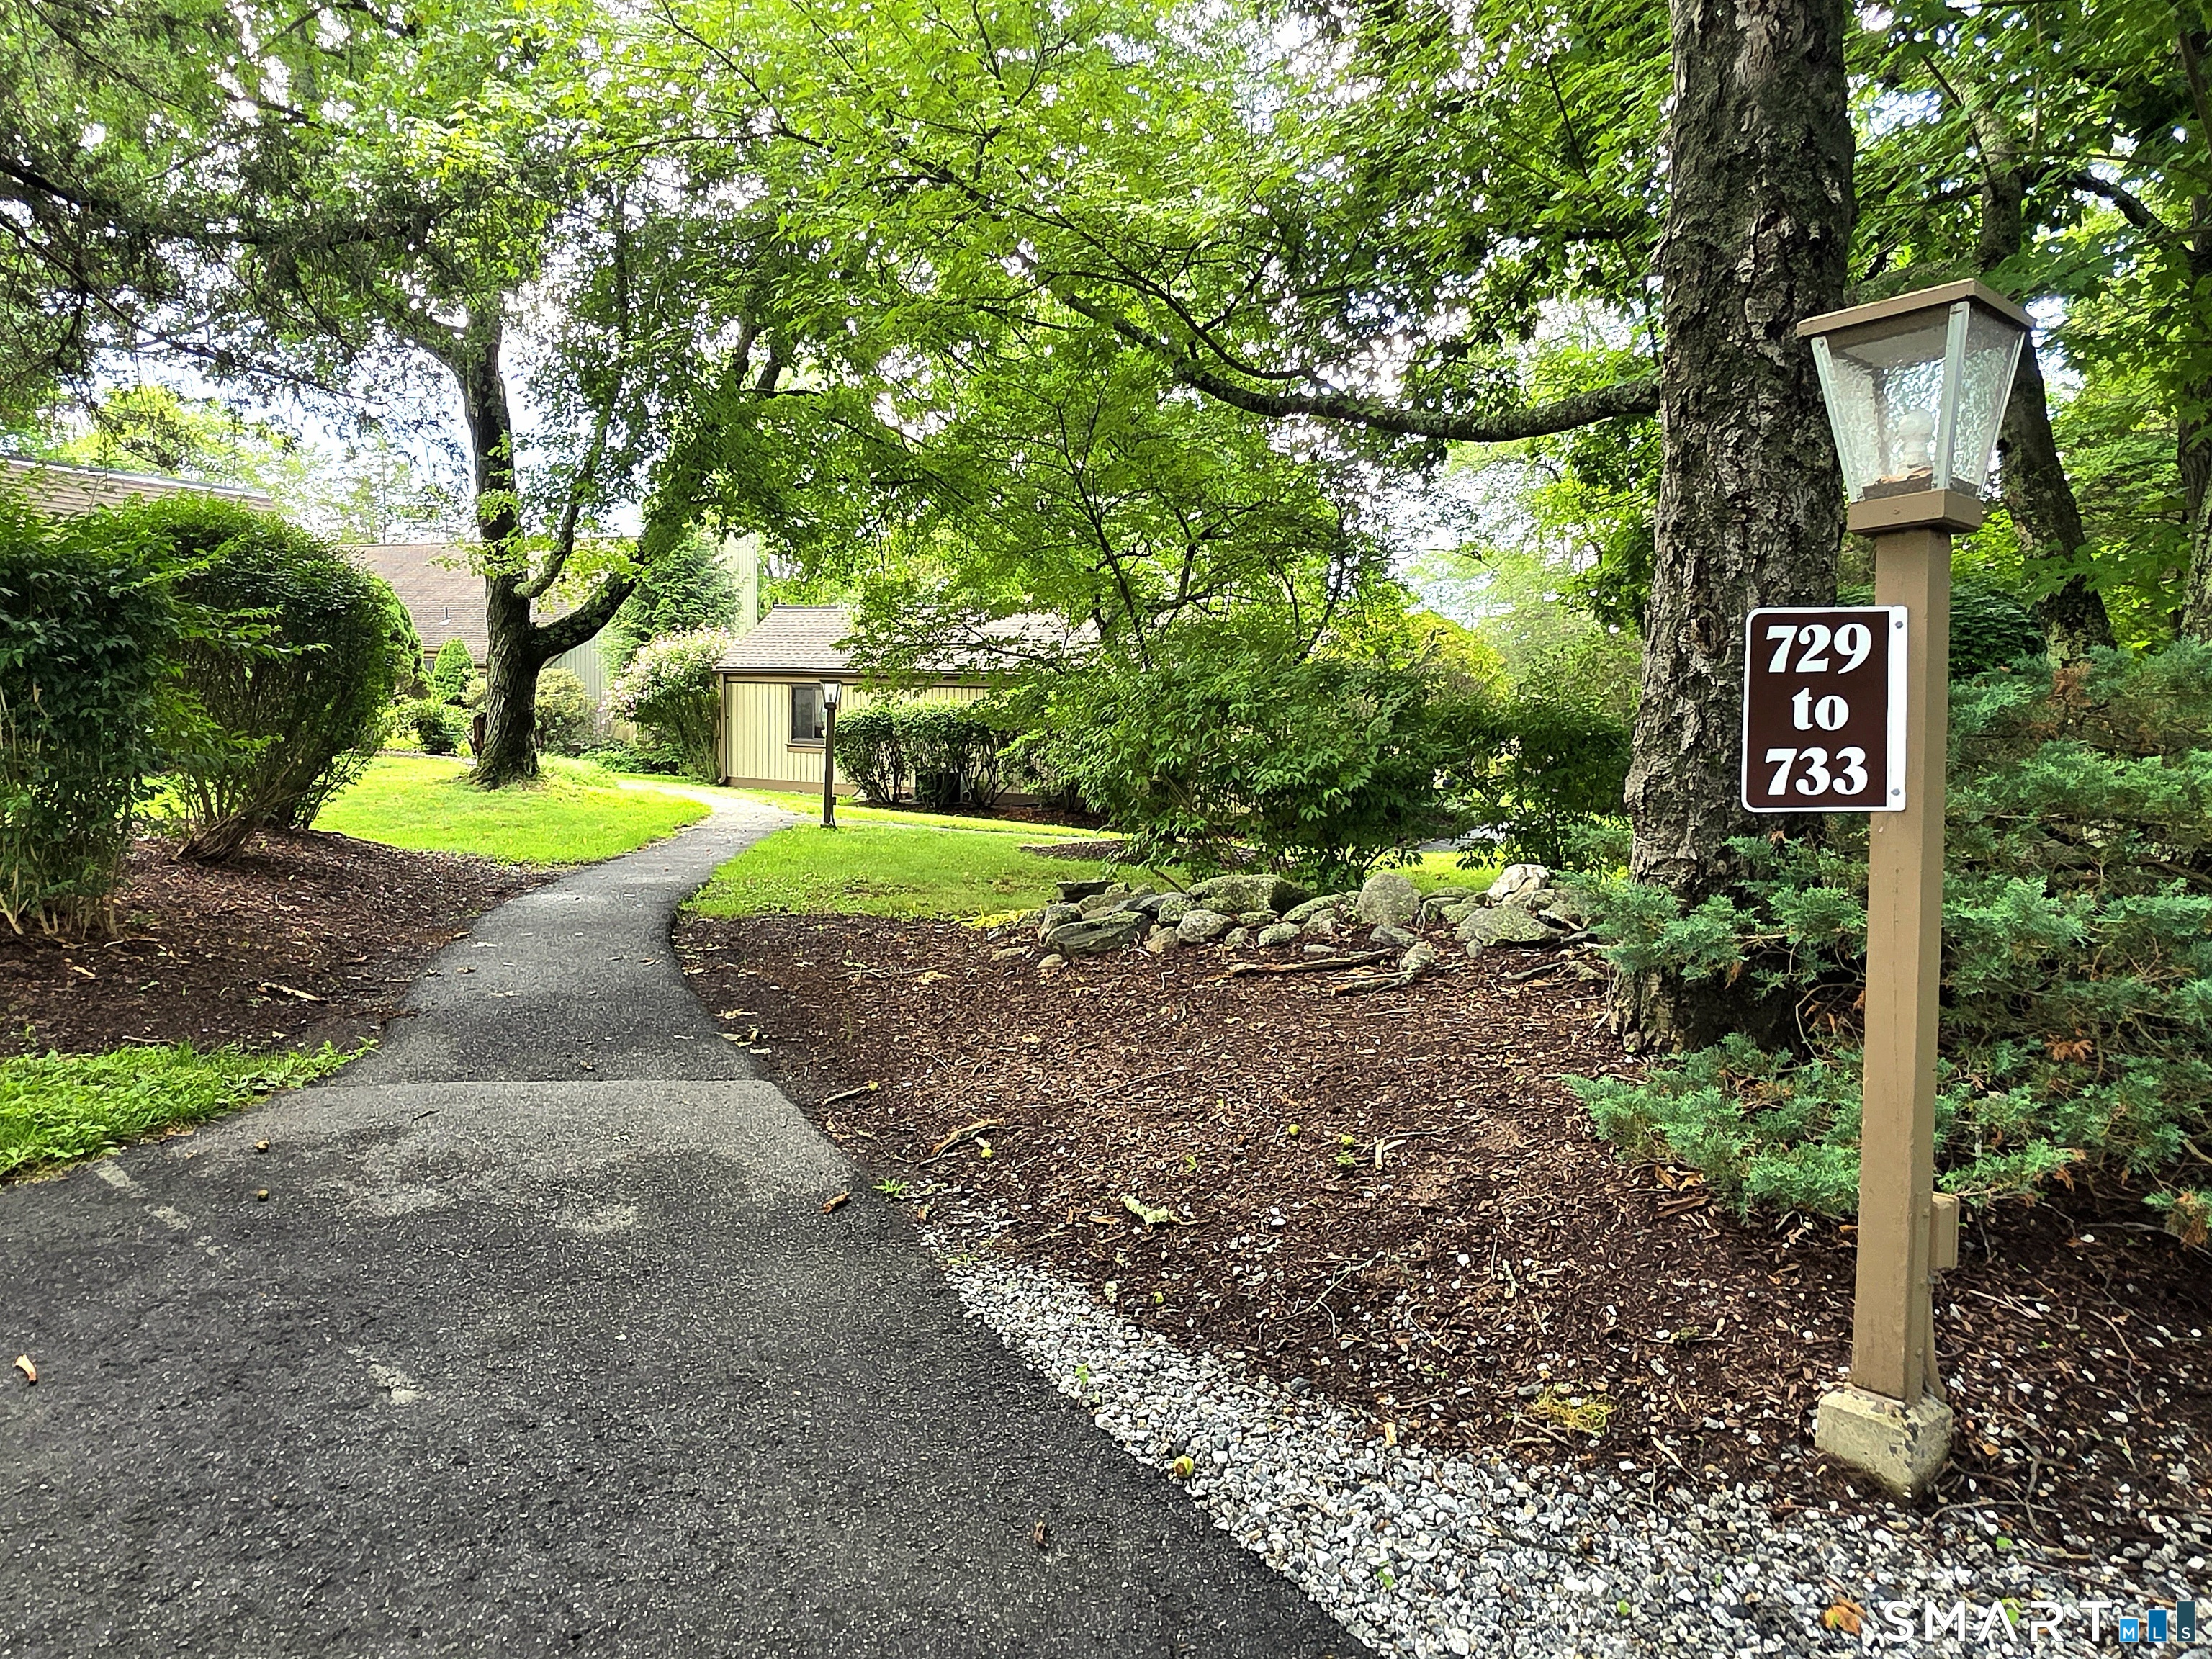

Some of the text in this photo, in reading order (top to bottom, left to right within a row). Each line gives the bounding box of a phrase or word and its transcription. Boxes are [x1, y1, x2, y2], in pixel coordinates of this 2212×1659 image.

[1766, 623, 1872, 675] 729
[1791, 687, 1850, 731] to
[1765, 746, 1869, 796] 733
